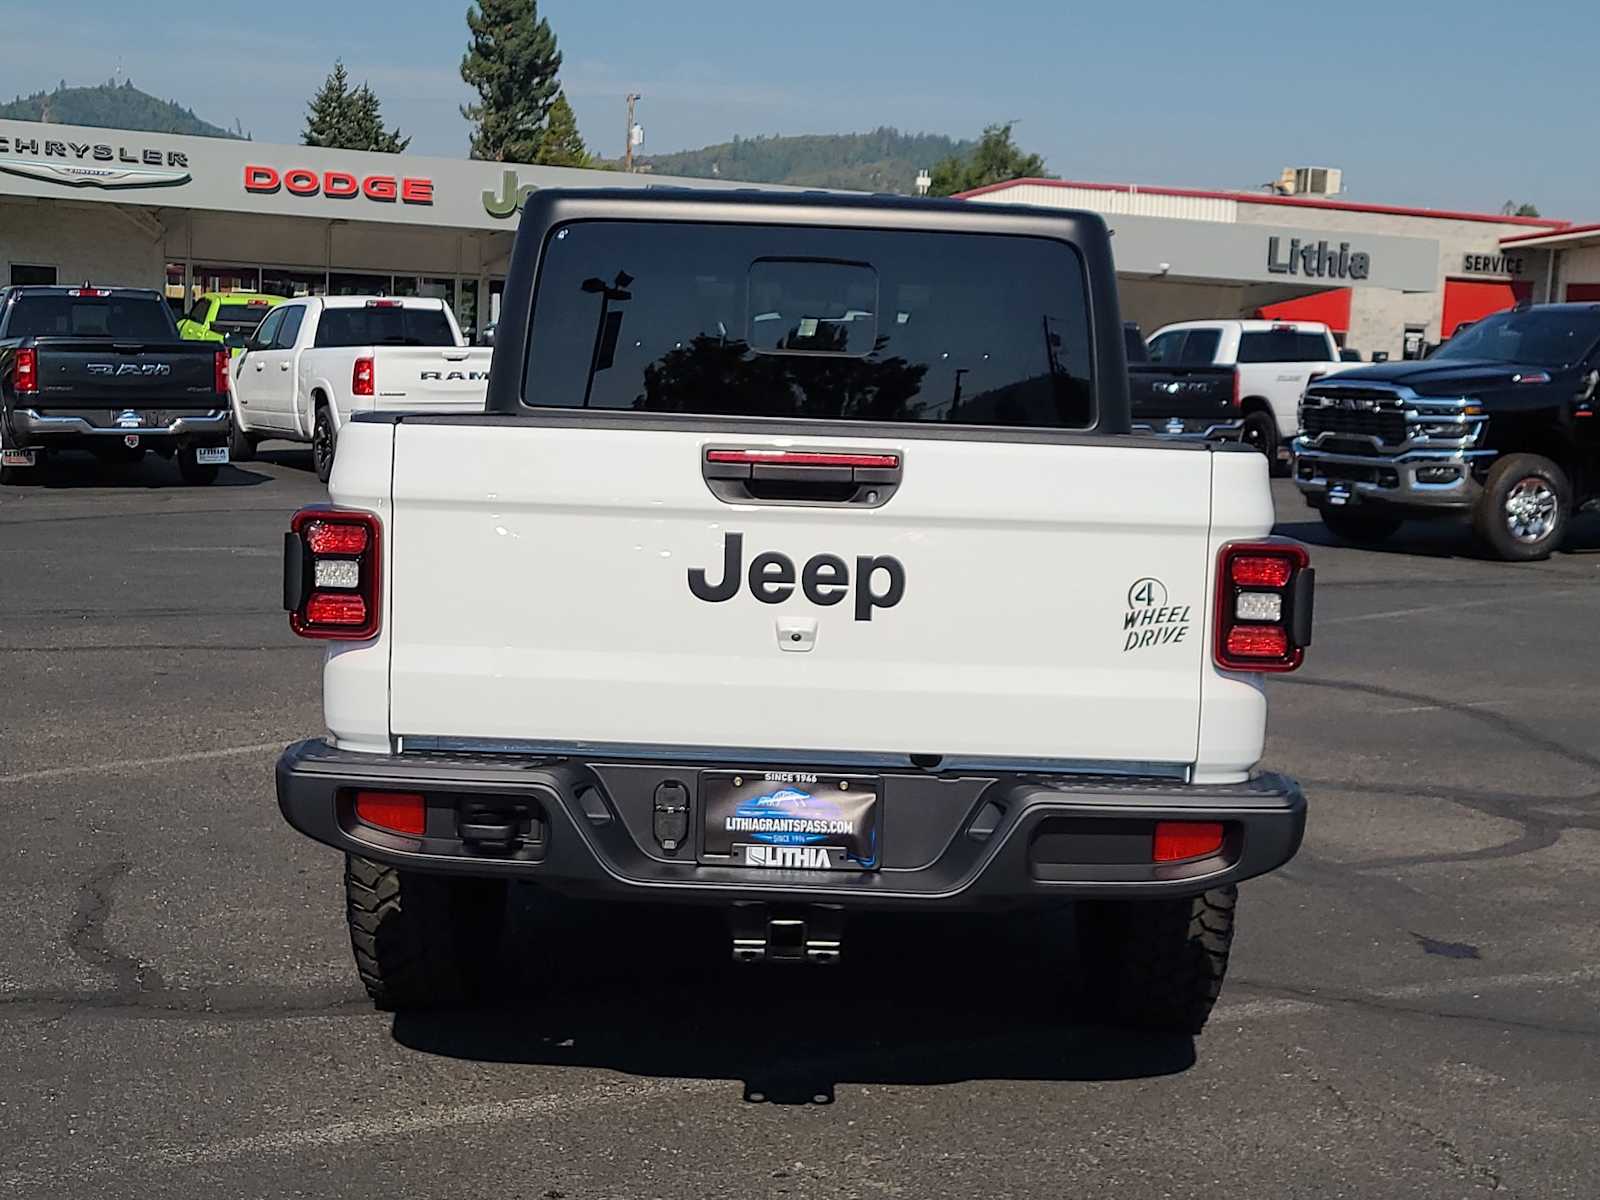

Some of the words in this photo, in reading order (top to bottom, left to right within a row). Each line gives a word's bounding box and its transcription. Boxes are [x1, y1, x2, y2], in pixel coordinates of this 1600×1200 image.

[244, 165, 434, 206] DODGE
[1267, 236, 1370, 280] Lithia
[1465, 254, 1524, 274] SERVICE
[420, 371, 490, 381] RAM
[687, 532, 906, 622] Jeep
[1134, 581, 1155, 607] 4
[1123, 605, 1191, 631] WHEEL
[1123, 625, 1190, 652] DRIVE
[764, 772, 793, 783] SINCE
[796, 774, 818, 784] 1946
[725, 816, 853, 834] LITHIAGRANTSPASS.COM
[765, 846, 831, 869] LITHIA
